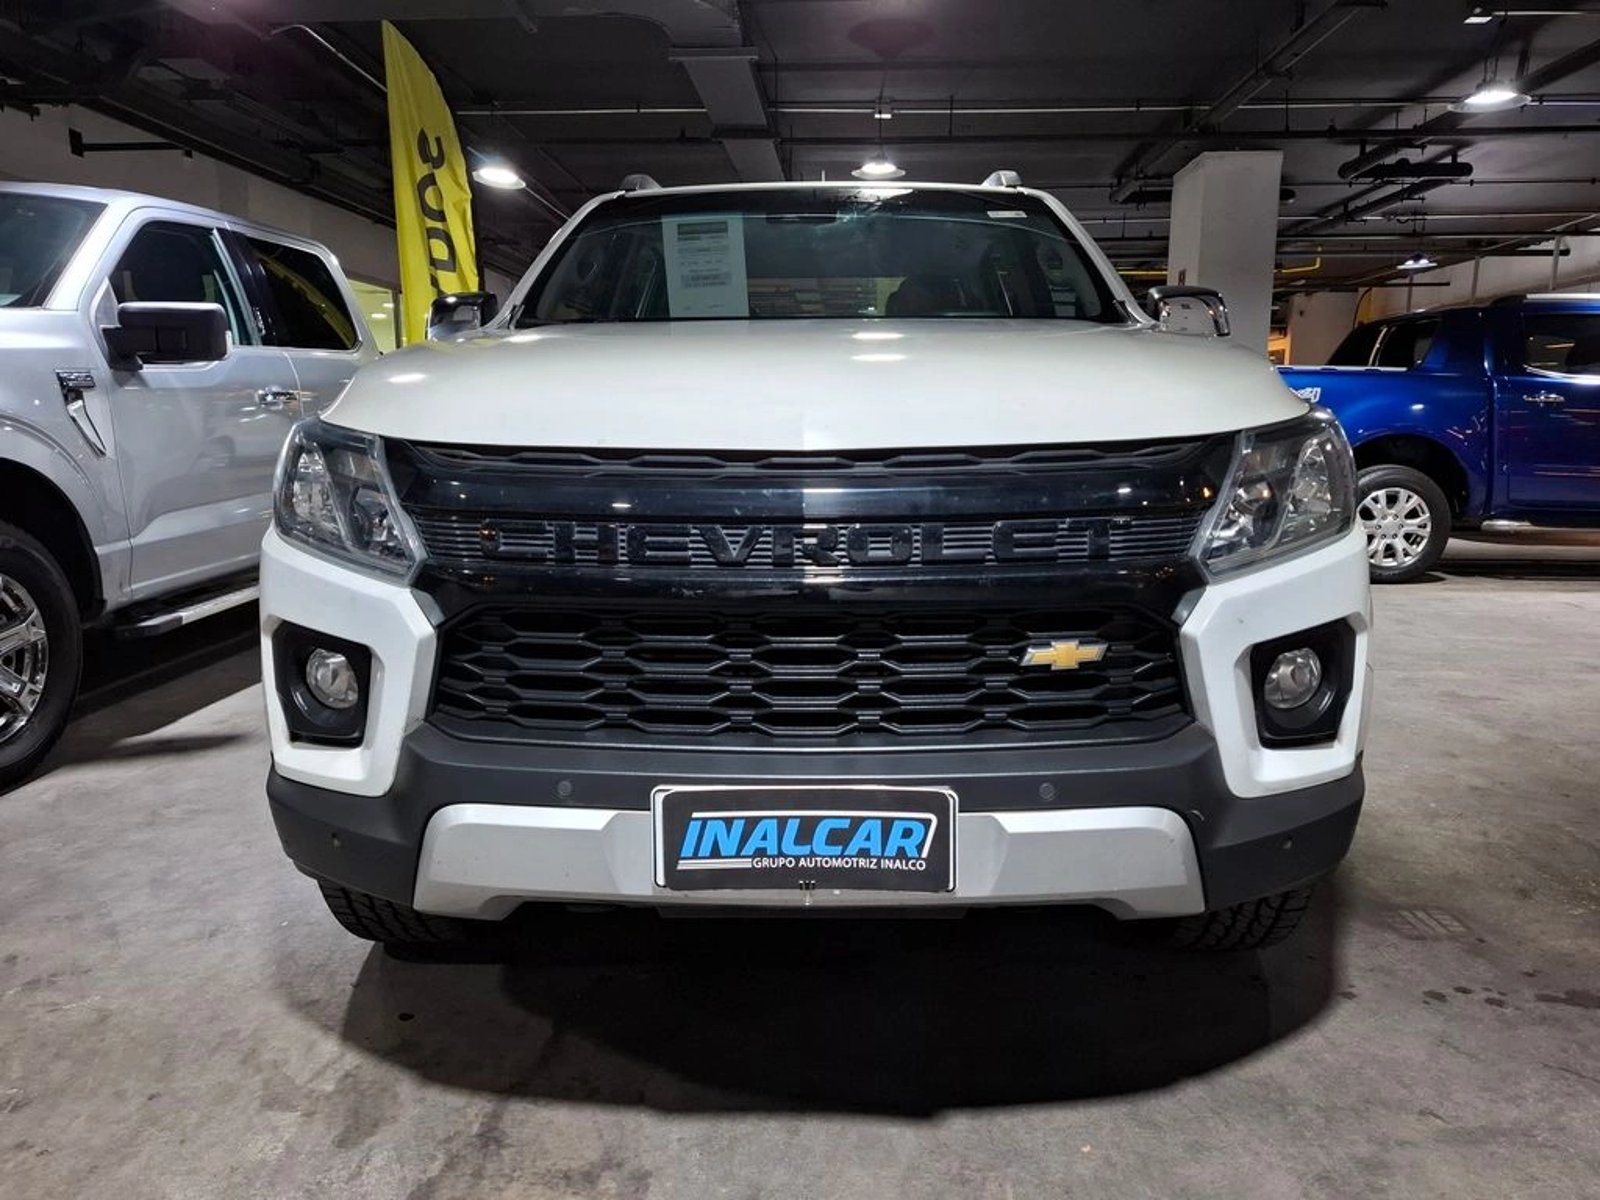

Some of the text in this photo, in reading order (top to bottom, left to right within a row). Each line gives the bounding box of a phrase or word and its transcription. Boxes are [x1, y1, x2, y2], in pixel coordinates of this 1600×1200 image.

[480, 518, 1131, 566] CHEVROLET
[680, 818, 925, 857] INALCAR
[752, 857, 926, 871] GRUPO AUTOMOTRIZ INALCO
